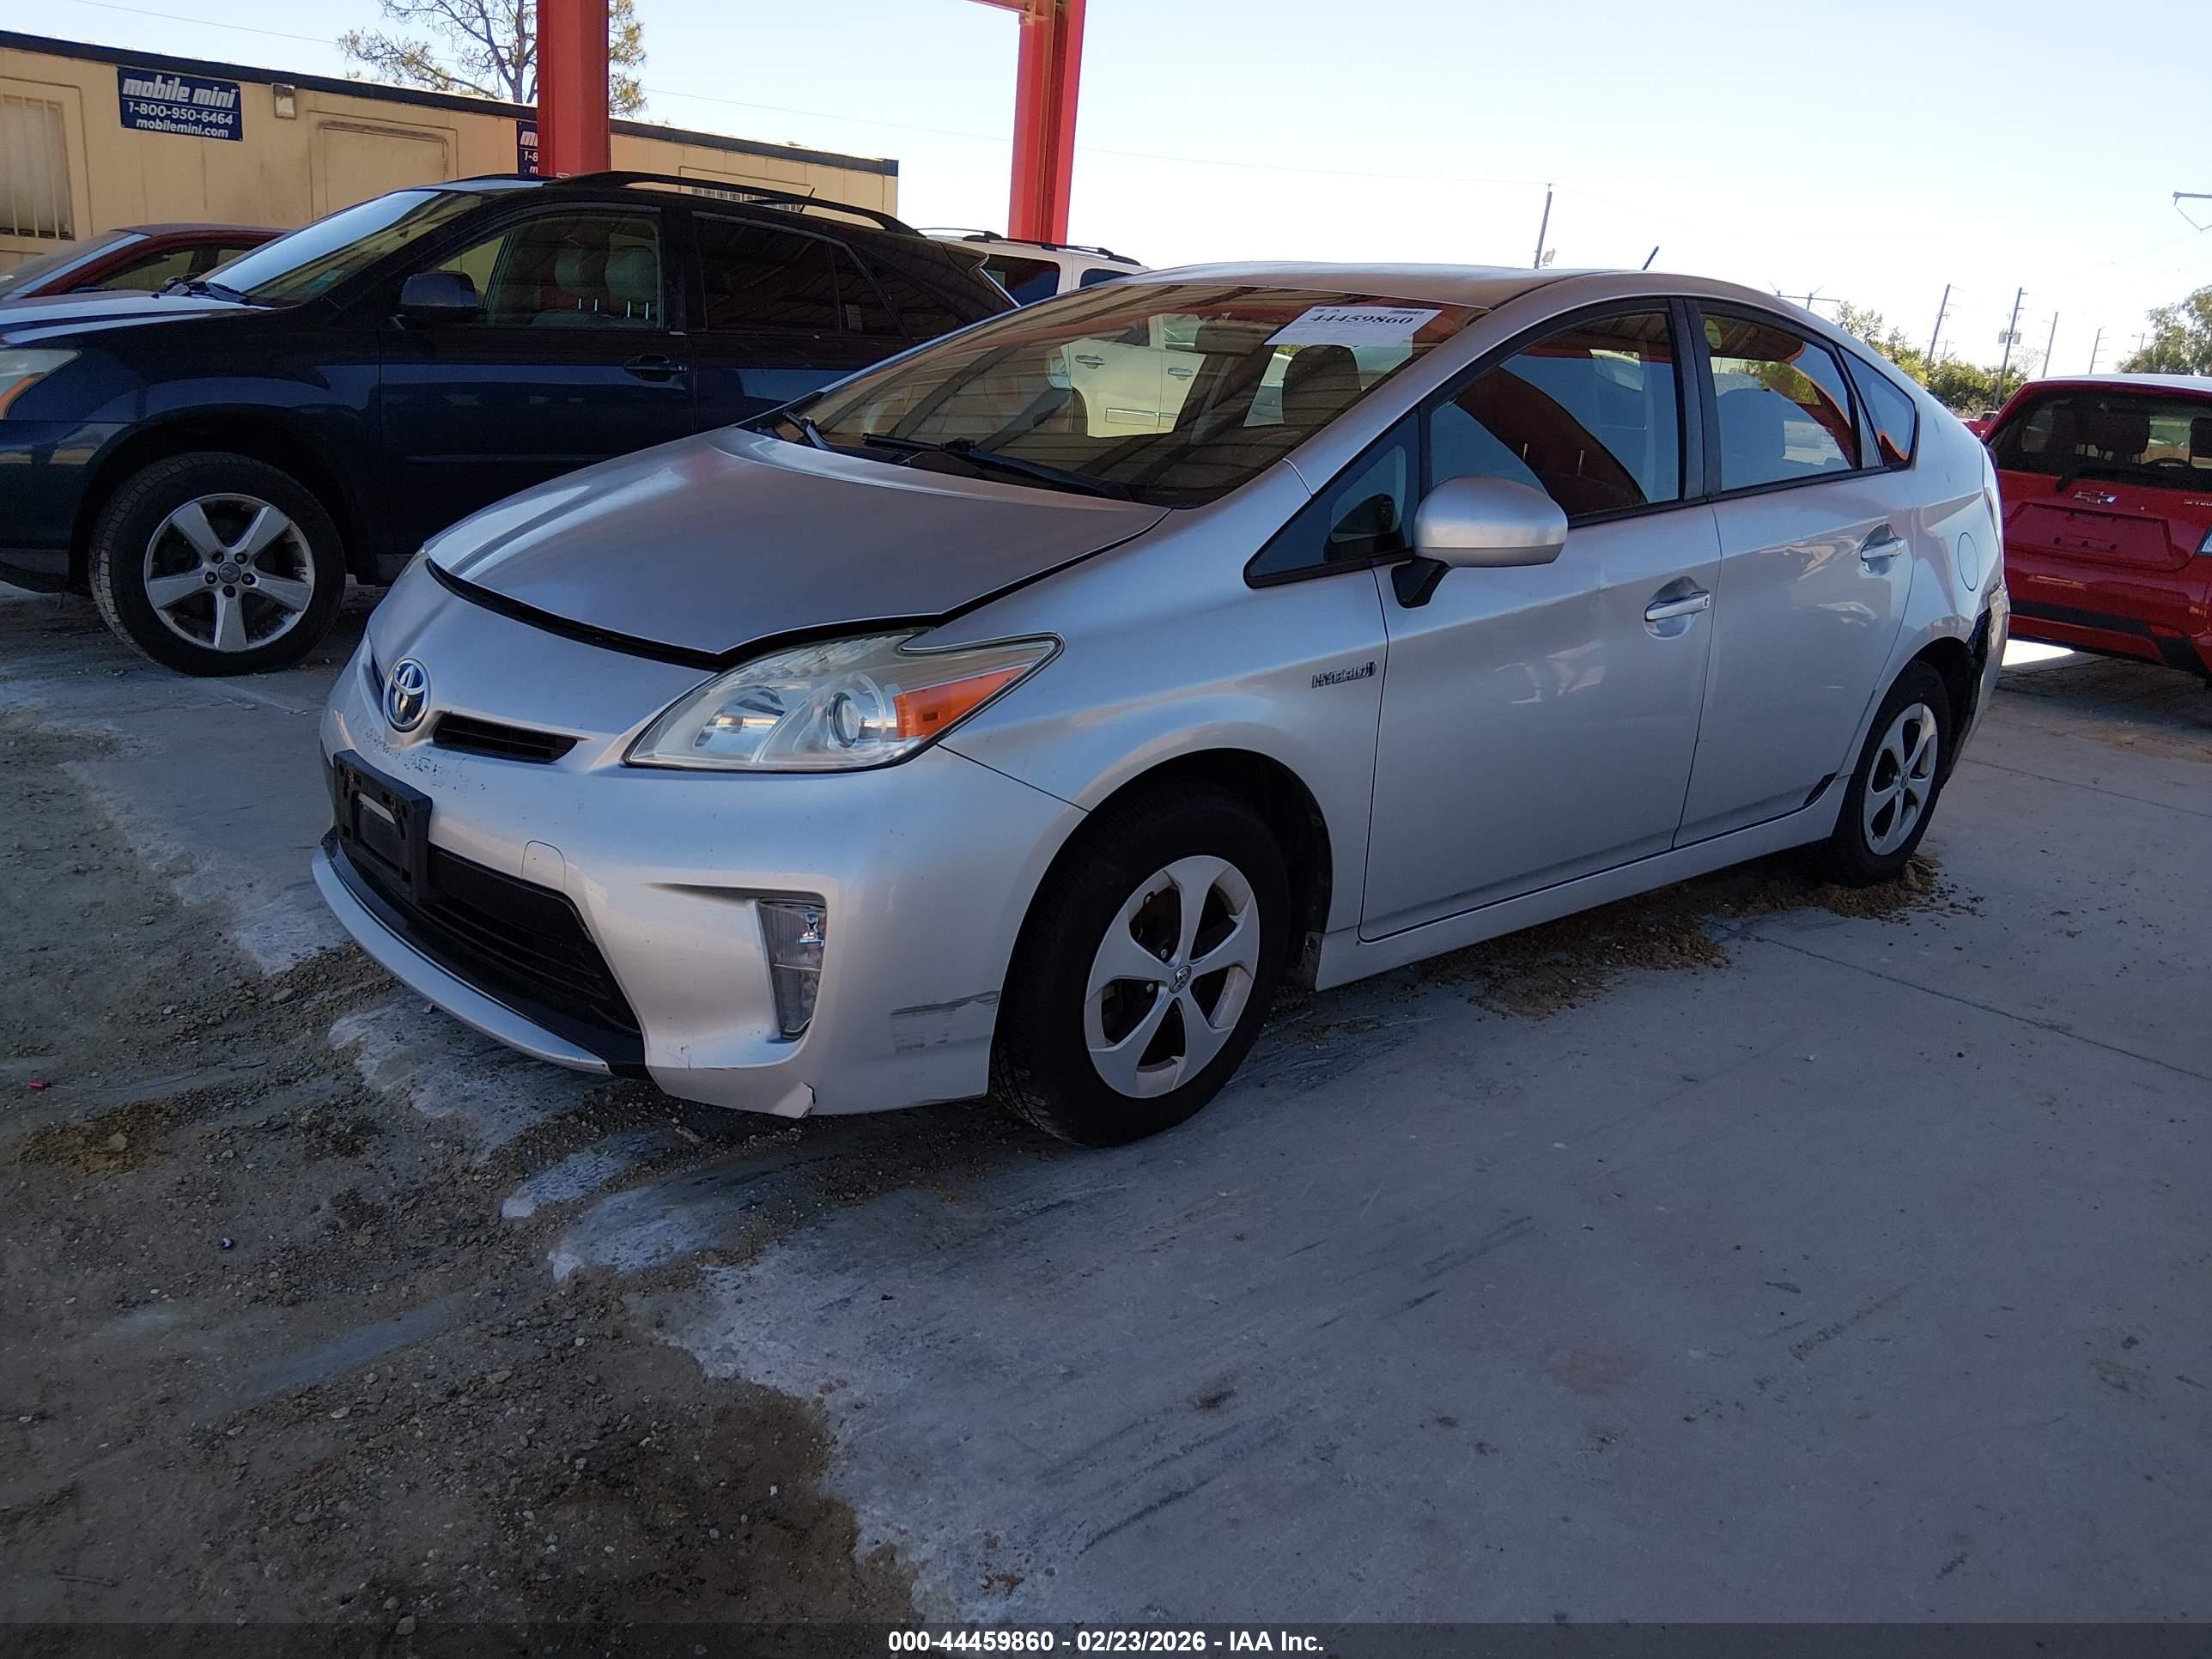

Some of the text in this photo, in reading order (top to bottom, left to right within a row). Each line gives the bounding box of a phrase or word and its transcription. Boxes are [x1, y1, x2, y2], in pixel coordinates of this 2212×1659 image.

[123, 75, 236, 108] mobile mini
[129, 102, 234, 125] 1-800-950-6464
[136, 118, 228, 137] mobilemini.com
[1310, 314, 1414, 325] 44459860
